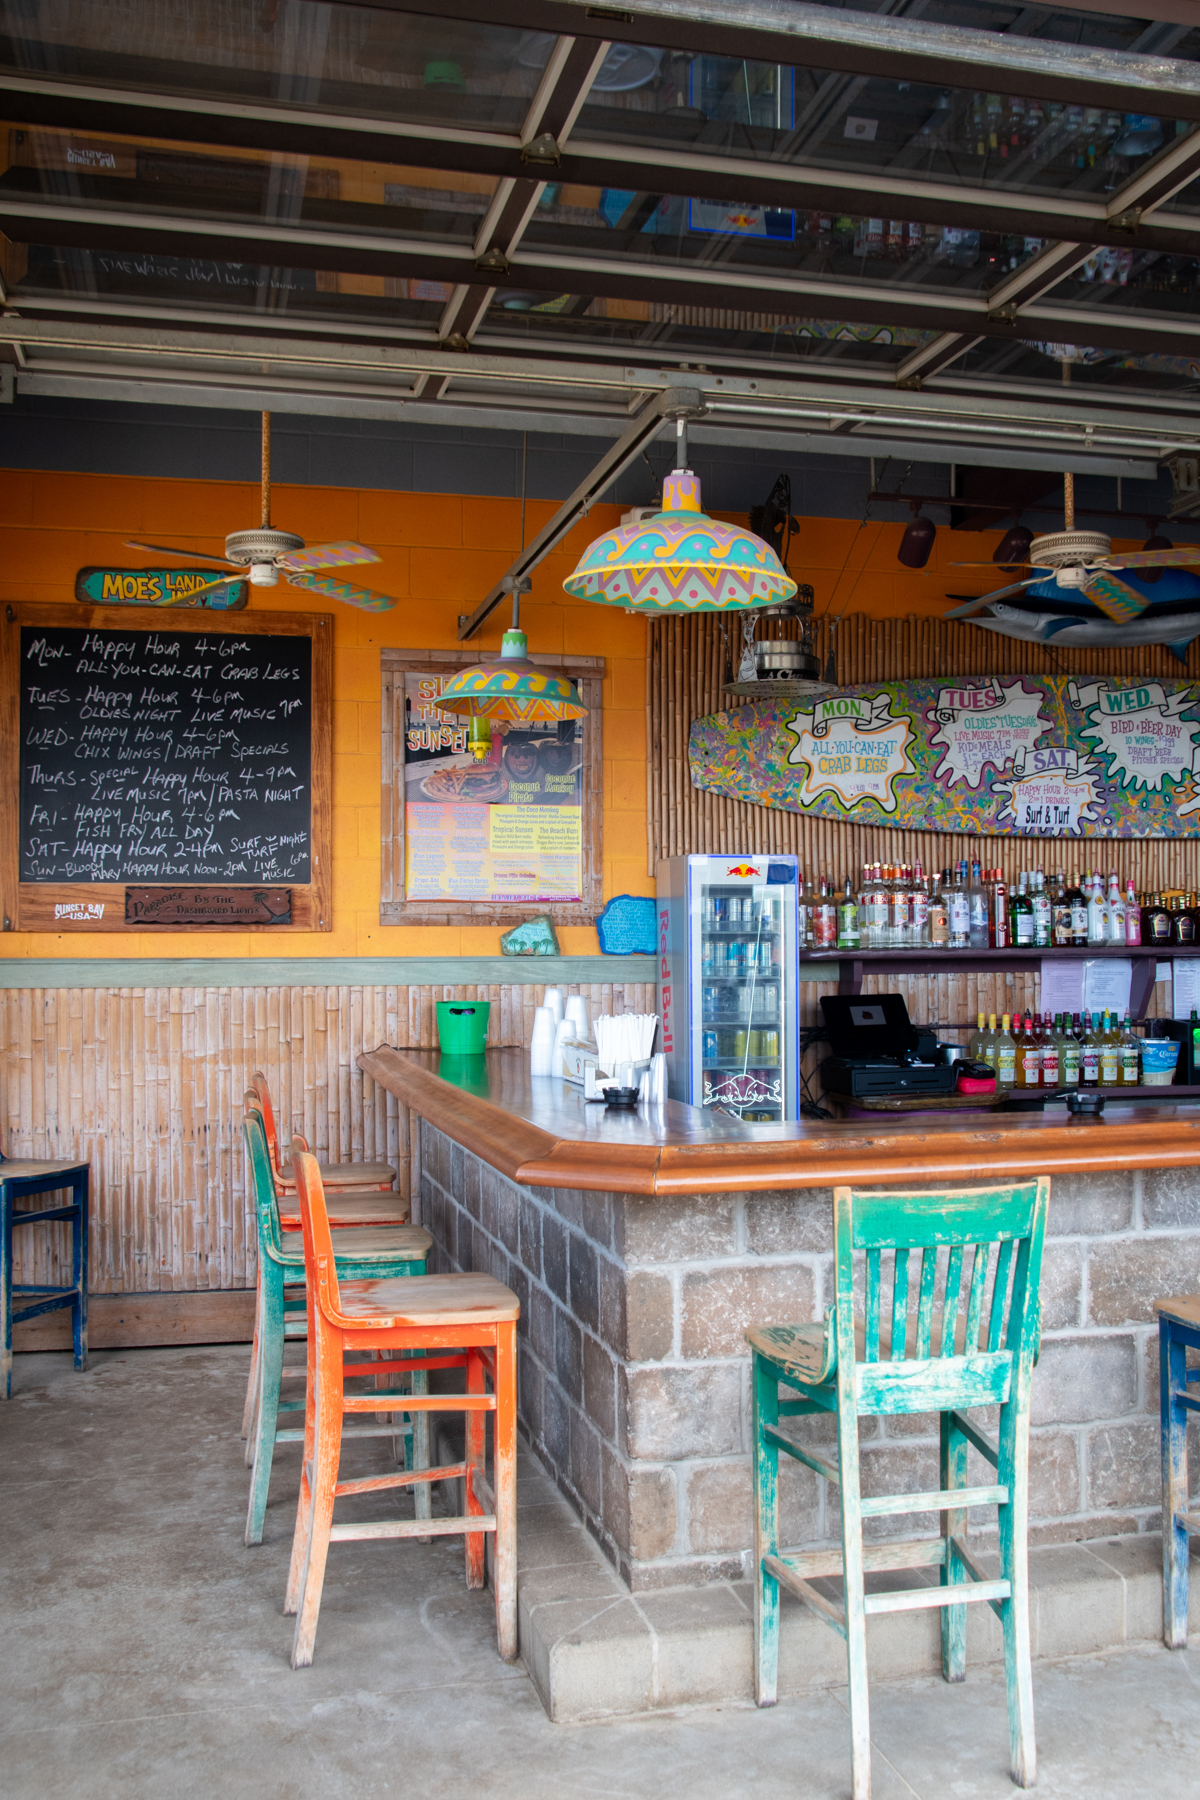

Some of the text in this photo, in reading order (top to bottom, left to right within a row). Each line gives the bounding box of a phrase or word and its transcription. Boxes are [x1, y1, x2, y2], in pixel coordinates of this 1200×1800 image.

[102, 572, 208, 602] MOE'S LAND
[417, 702, 454, 725] THE
[964, 716, 997, 730] OLDIES
[1110, 719, 1134, 734] BIRD
[1140, 720, 1164, 736] BEER
[1165, 724, 1183, 739] DAY
[407, 724, 470, 754] SUNSET
[954, 730, 971, 742] LIVE
[971, 729, 995, 741] MUSIC
[978, 739, 1012, 753] MEALS
[1127, 746, 1172, 757] DRAFT BEER
[981, 750, 1006, 760] EACH
[1131, 756, 1158, 765] PITCHER
[818, 756, 889, 775] CRAB LEGS
[545, 773, 576, 784] Coconut
[508, 780, 541, 792] Coconut
[544, 783, 575, 794] Monkey
[1018, 784, 1042, 796] HAPPY
[1043, 783, 1061, 795] HOUR
[508, 792, 534, 802] Pirate
[1045, 796, 1070, 805] DRINKS
[1025, 805, 1070, 824] Surf & Turf
[54, 903, 105, 920] SUNSET BAY
[658, 909, 674, 1054] Red Bull
